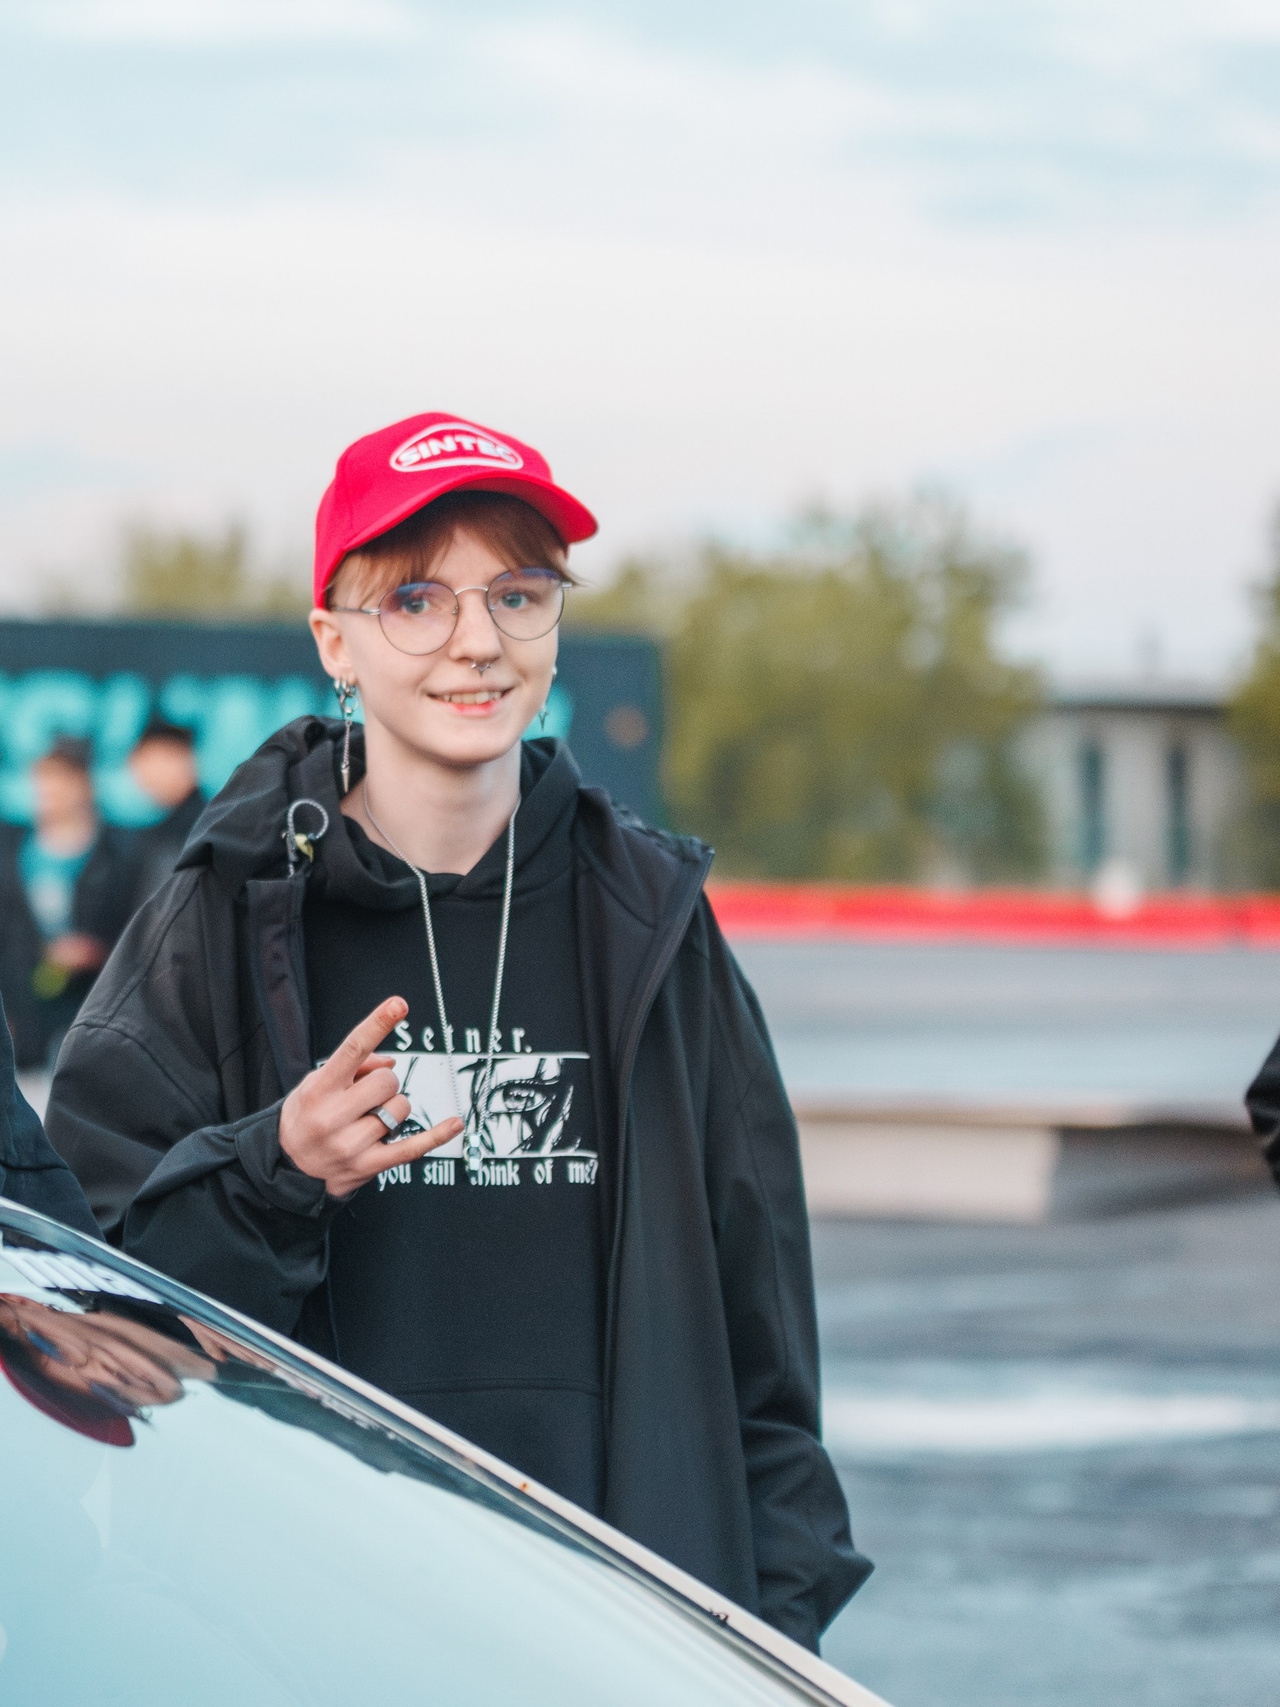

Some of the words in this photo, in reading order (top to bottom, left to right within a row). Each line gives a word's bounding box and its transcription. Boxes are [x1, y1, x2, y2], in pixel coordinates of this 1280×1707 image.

[397, 434, 517, 467] SINTEC
[376, 1162, 413, 1192] you
[422, 1158, 456, 1187] still
[532, 1158, 555, 1186] of
[566, 1158, 599, 1186] me?
